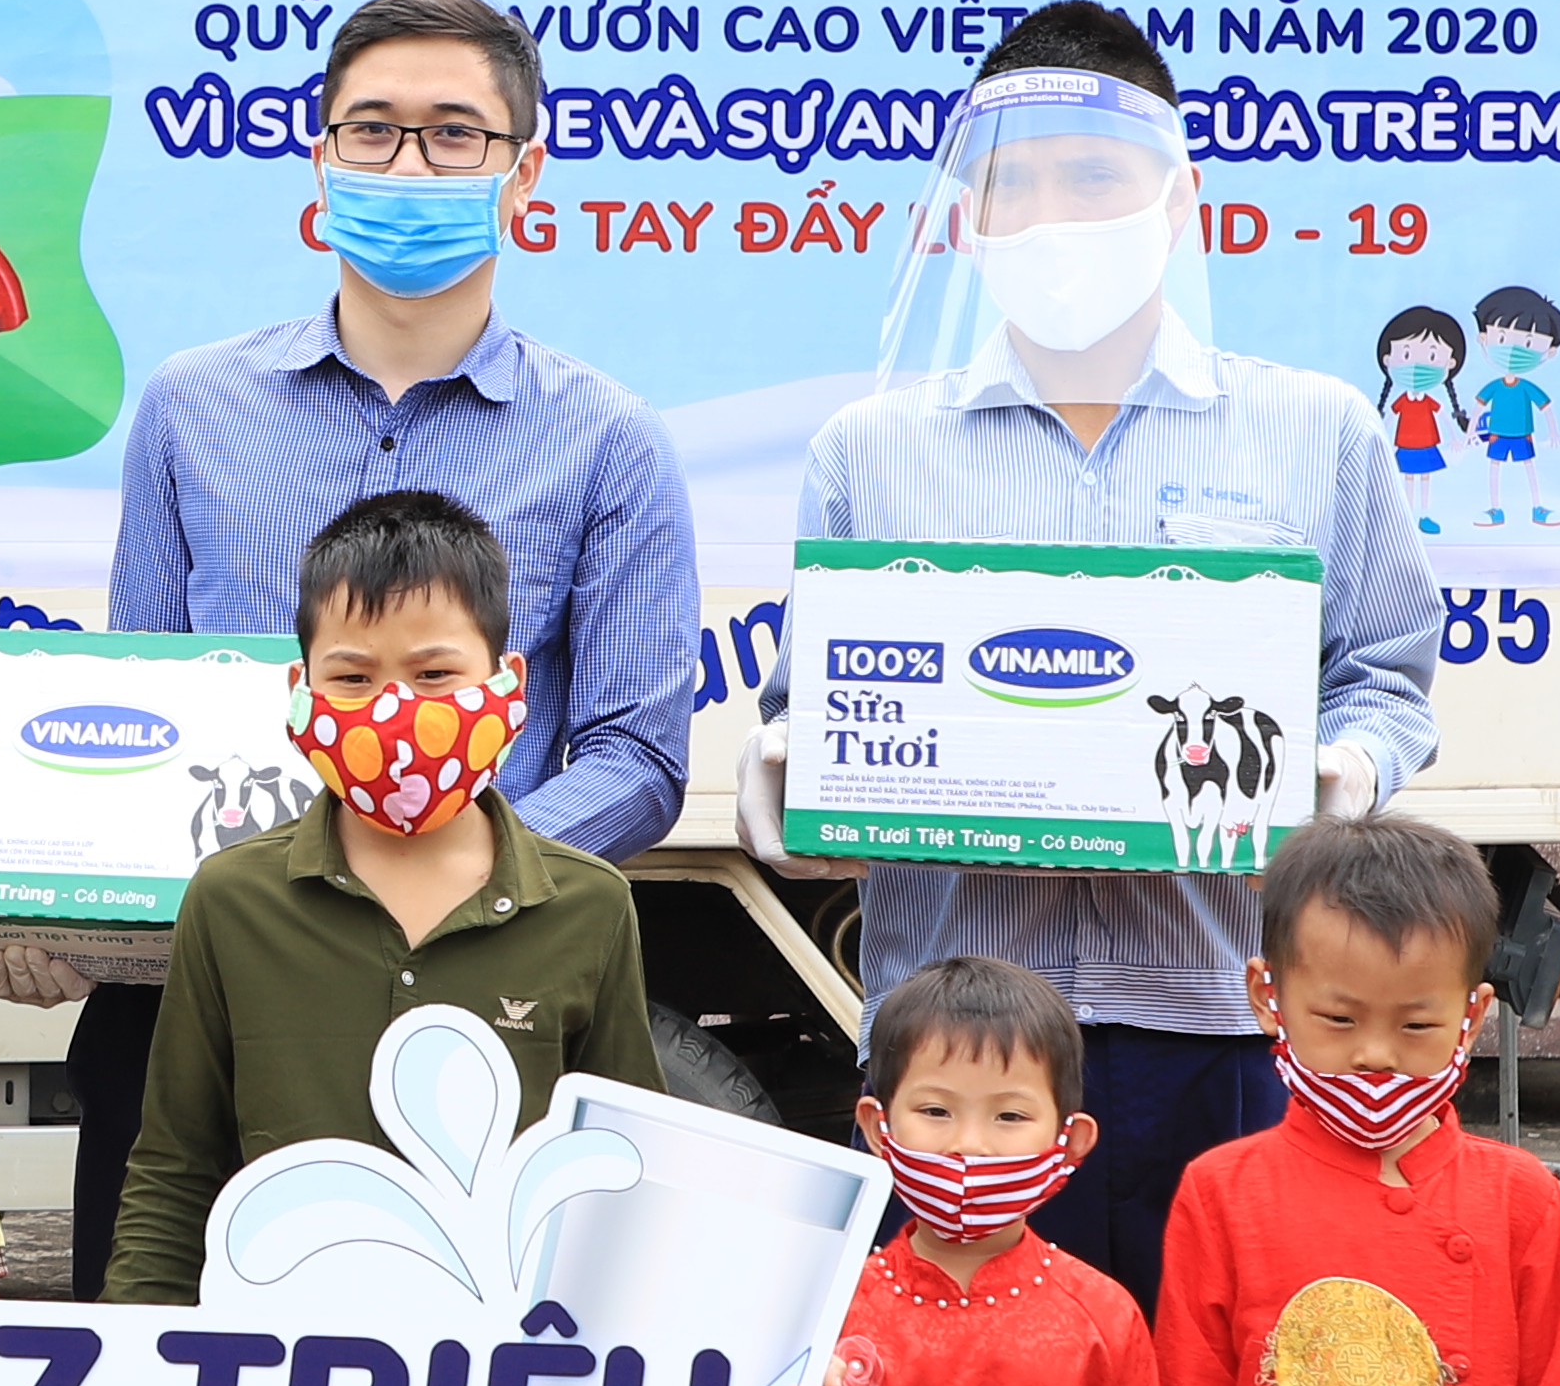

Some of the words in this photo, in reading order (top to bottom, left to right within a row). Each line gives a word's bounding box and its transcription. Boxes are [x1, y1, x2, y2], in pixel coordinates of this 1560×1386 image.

[724, 6, 860, 52] CAO
[1387, 8, 1538, 54] 2020
[975, 78, 1017, 103] Face
[1025, 76, 1095, 94] Shield
[150, 78, 229, 154] VÌ
[605, 80, 713, 154] VÀ
[722, 83, 826, 168] SỰ
[832, 94, 939, 154] AN
[1178, 81, 1315, 157] CỦA
[1323, 82, 1463, 156] TRẺ
[580, 201, 712, 253] TAY
[735, 180, 884, 253] ĐẨY
[1348, 204, 1428, 255] 19
[833, 645, 941, 678] 100%
[979, 646, 1126, 677] VINAMILK
[826, 690, 905, 725] Sữa
[31, 720, 172, 747] VINAMILK
[825, 728, 940, 769] Tươi
[820, 824, 860, 843] Sữa
[865, 825, 910, 845] Tươi
[916, 827, 955, 849] Tiệt
[960, 829, 1021, 852] Trùng
[1041, 834, 1066, 851] Có
[1070, 835, 1126, 856] Đường
[75, 886, 99, 904] Có
[103, 888, 157, 909] Đường
